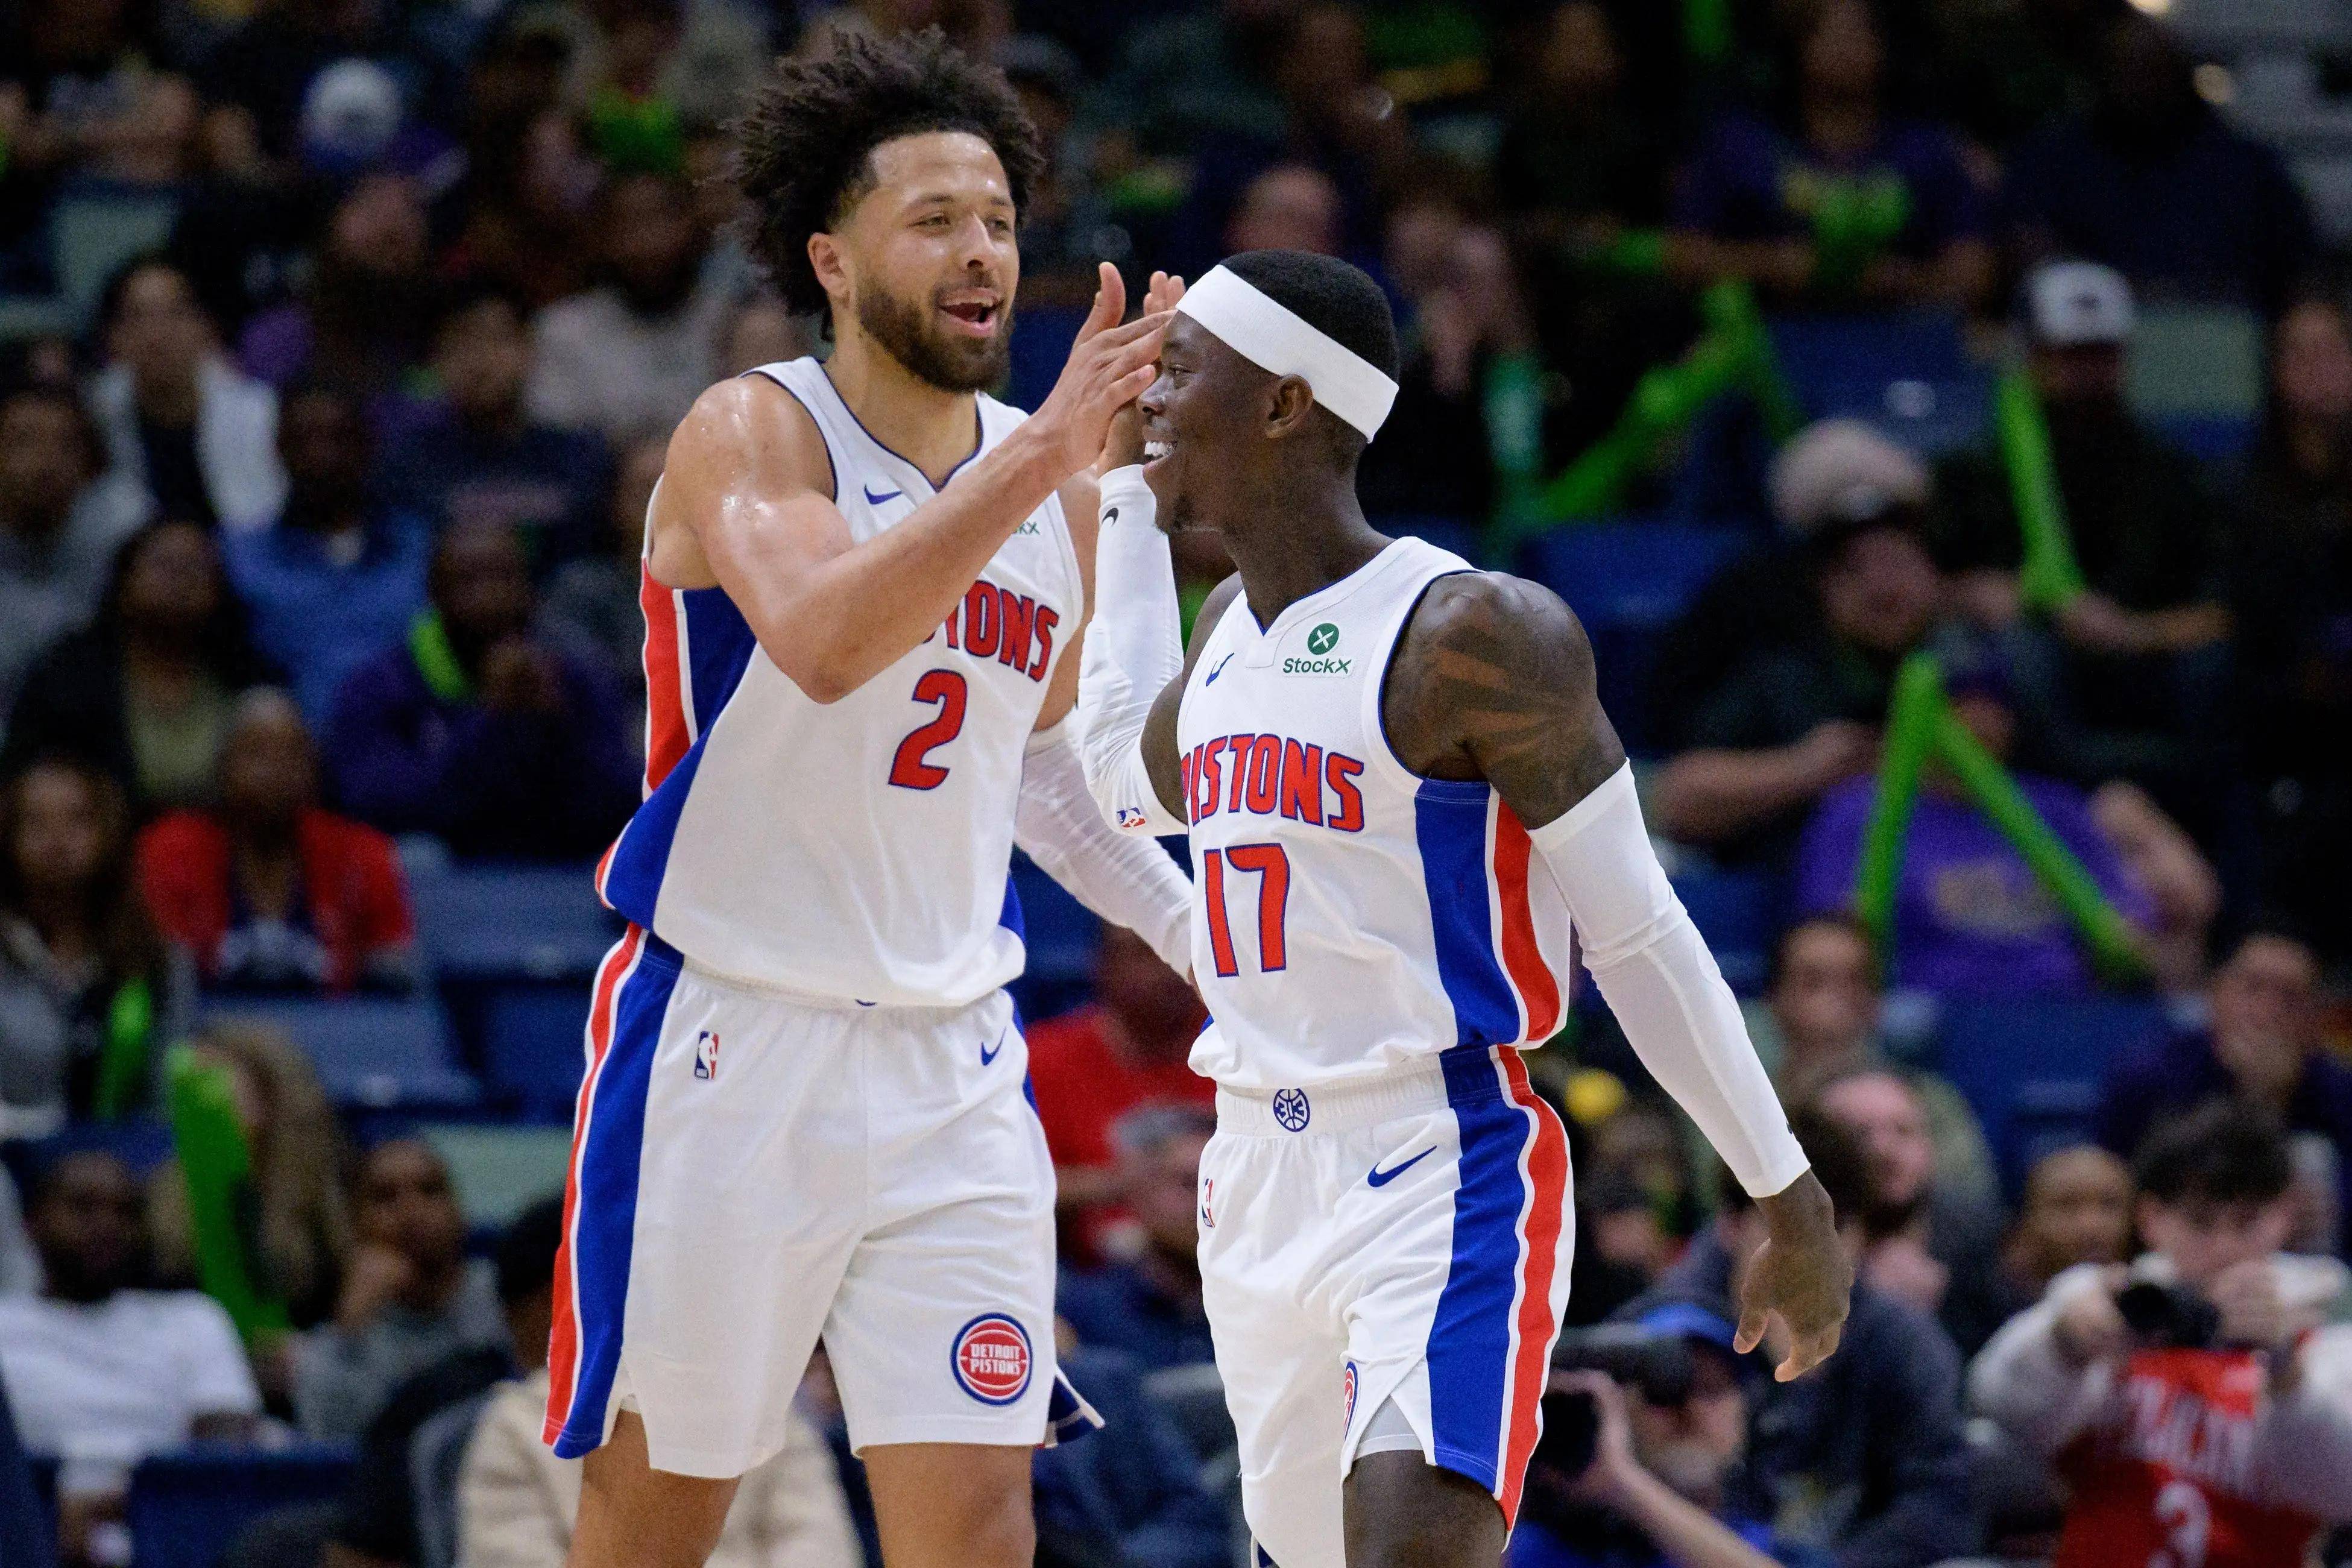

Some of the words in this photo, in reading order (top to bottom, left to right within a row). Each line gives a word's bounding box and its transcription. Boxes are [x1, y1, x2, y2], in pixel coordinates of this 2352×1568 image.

[1282, 657, 1352, 674] StockX
[888, 669, 968, 790] 2
[1203, 843, 1290, 978] 17
[970, 1343, 1020, 1359] DETROIT
[970, 1358, 1020, 1375] PISTONS
